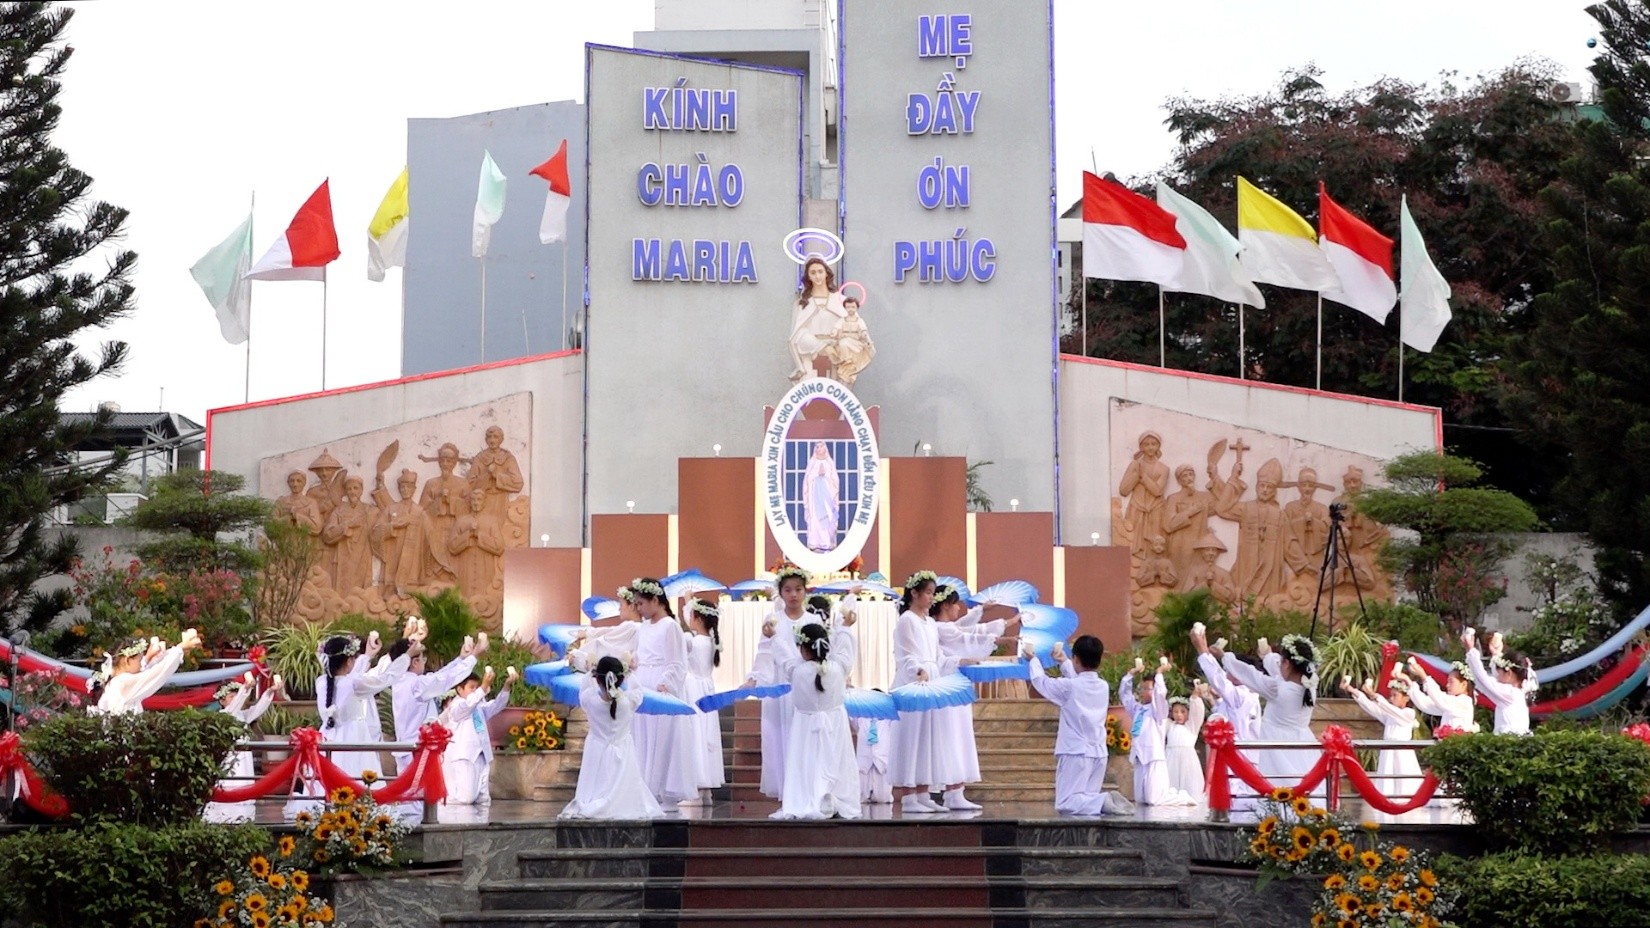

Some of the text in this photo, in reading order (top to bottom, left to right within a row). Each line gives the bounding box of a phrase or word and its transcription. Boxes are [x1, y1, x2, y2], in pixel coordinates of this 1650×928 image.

[918, 13, 973, 70] MẸ
[643, 76, 738, 132] KÍNH
[905, 71, 982, 135] ĐẦY
[637, 152, 745, 208] CHÀO
[917, 156, 971, 210] ƠN
[632, 237, 759, 283] MARIA
[893, 227, 997, 283] PHÚC
[790, 382, 824, 404] CHÚNG
[826, 385, 848, 403] CON
[777, 403, 793, 423] CHO
[768, 424, 784, 444] CẦU
[857, 427, 872, 452] CHẠY
[768, 446, 779, 462] XIN
[767, 464, 778, 493] MARIA
[863, 475, 877, 492] KÊU
[769, 494, 781, 508] MẸ
[861, 493, 873, 510] XIN
[772, 510, 786, 527] LẠY
[855, 511, 870, 525] MẸ
